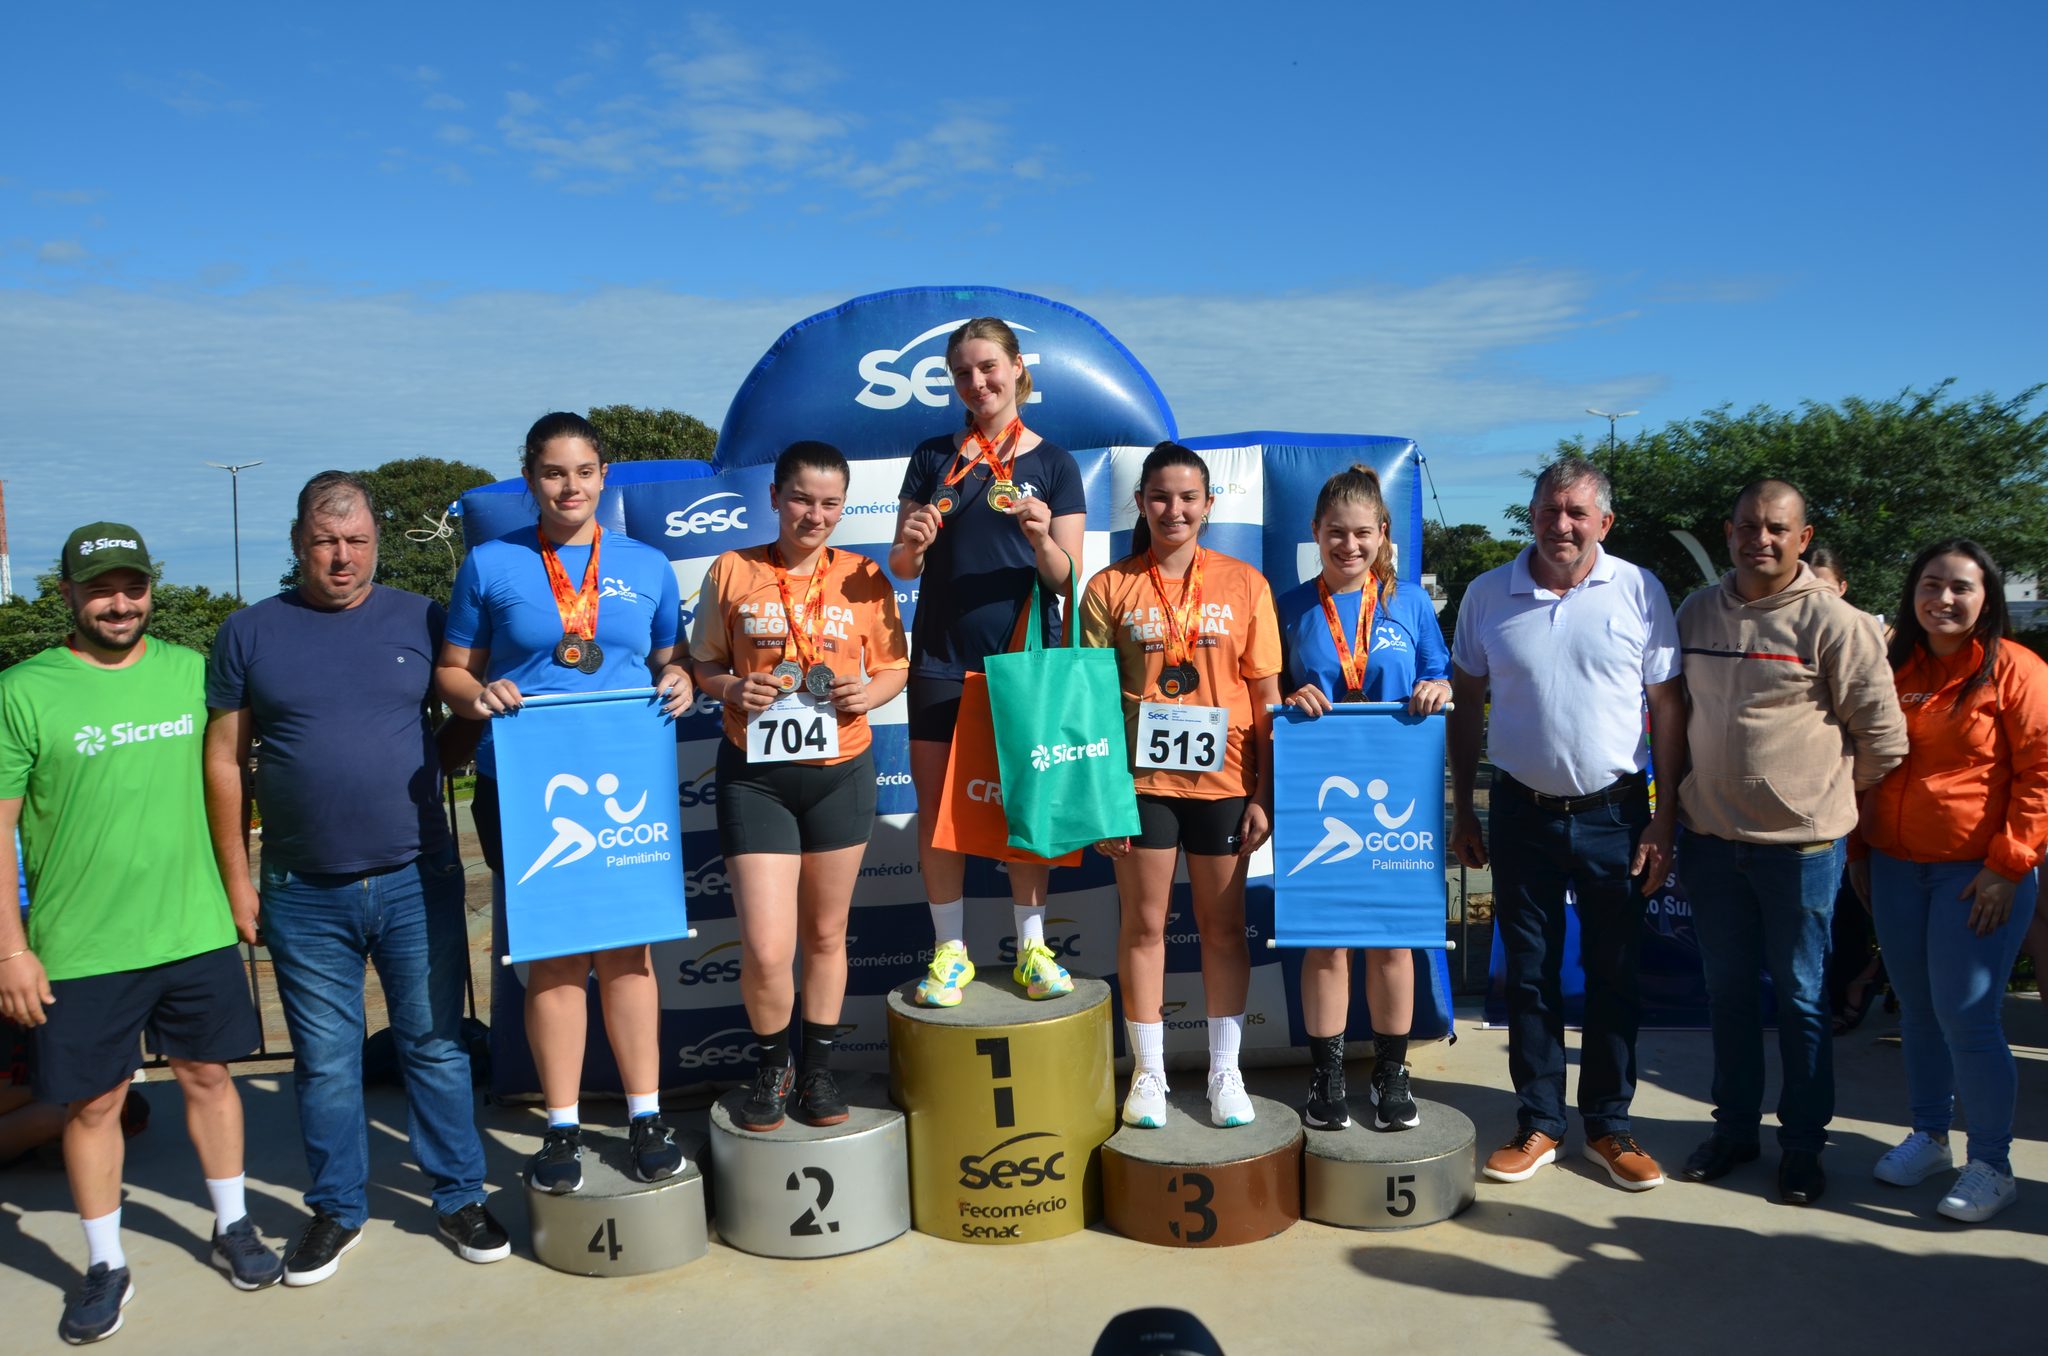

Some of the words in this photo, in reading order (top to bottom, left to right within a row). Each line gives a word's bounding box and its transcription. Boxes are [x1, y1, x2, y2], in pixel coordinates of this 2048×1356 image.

[664, 505, 748, 538] Sesc
[95, 538, 138, 550] Sicredi
[1148, 711, 1169, 721] Sesc
[111, 713, 193, 747] Sicredi
[758, 716, 827, 756] 704
[1053, 737, 1110, 764] Sicredi
[1148, 729, 1216, 767] 513
[597, 822, 670, 849] GCOR
[1365, 831, 1434, 852] GCOR
[606, 850, 671, 868] Palmitinho
[1372, 858, 1435, 870] Palmitinho
[678, 959, 741, 986] Ses
[847, 953, 913, 967] comércio
[1246, 1012, 1266, 1025] RS
[678, 1042, 761, 1069] Sesc
[975, 1036, 1016, 1129] 1
[958, 1151, 1066, 1190] Sesc
[785, 1166, 840, 1237] 2
[958, 1196, 1068, 1219] Fecomércio
[1167, 1172, 1218, 1243] 3
[1385, 1174, 1417, 1218] 5
[587, 1217, 623, 1261] 4
[961, 1223, 1021, 1239] Senac
